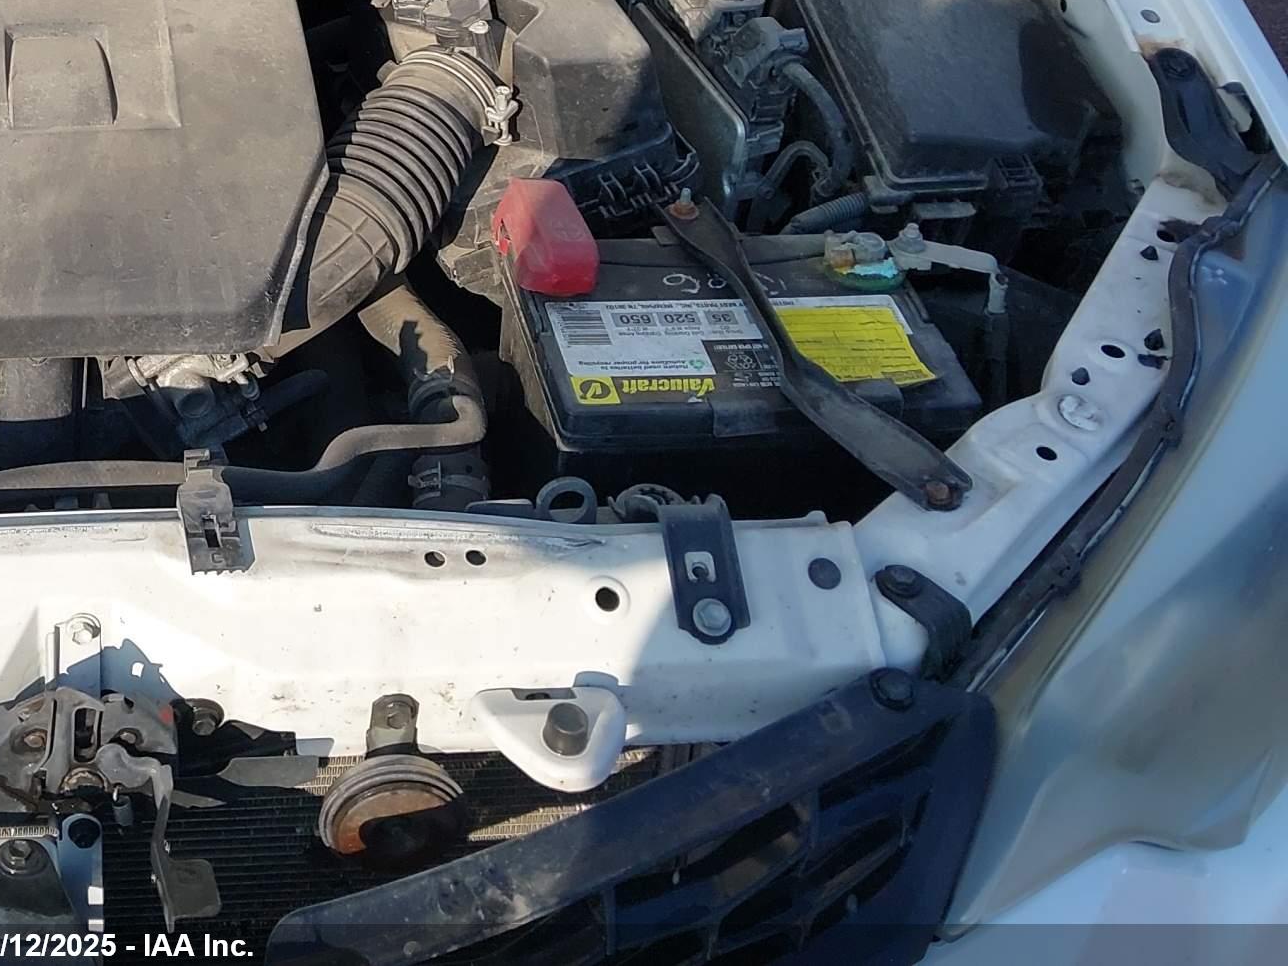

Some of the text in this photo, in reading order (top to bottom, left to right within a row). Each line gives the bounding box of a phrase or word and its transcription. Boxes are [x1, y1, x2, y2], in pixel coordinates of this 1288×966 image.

[619, 315, 651, 325] 650
[664, 314, 696, 324] 520
[711, 313, 732, 323] 35
[622, 378, 715, 397] Valucraft
